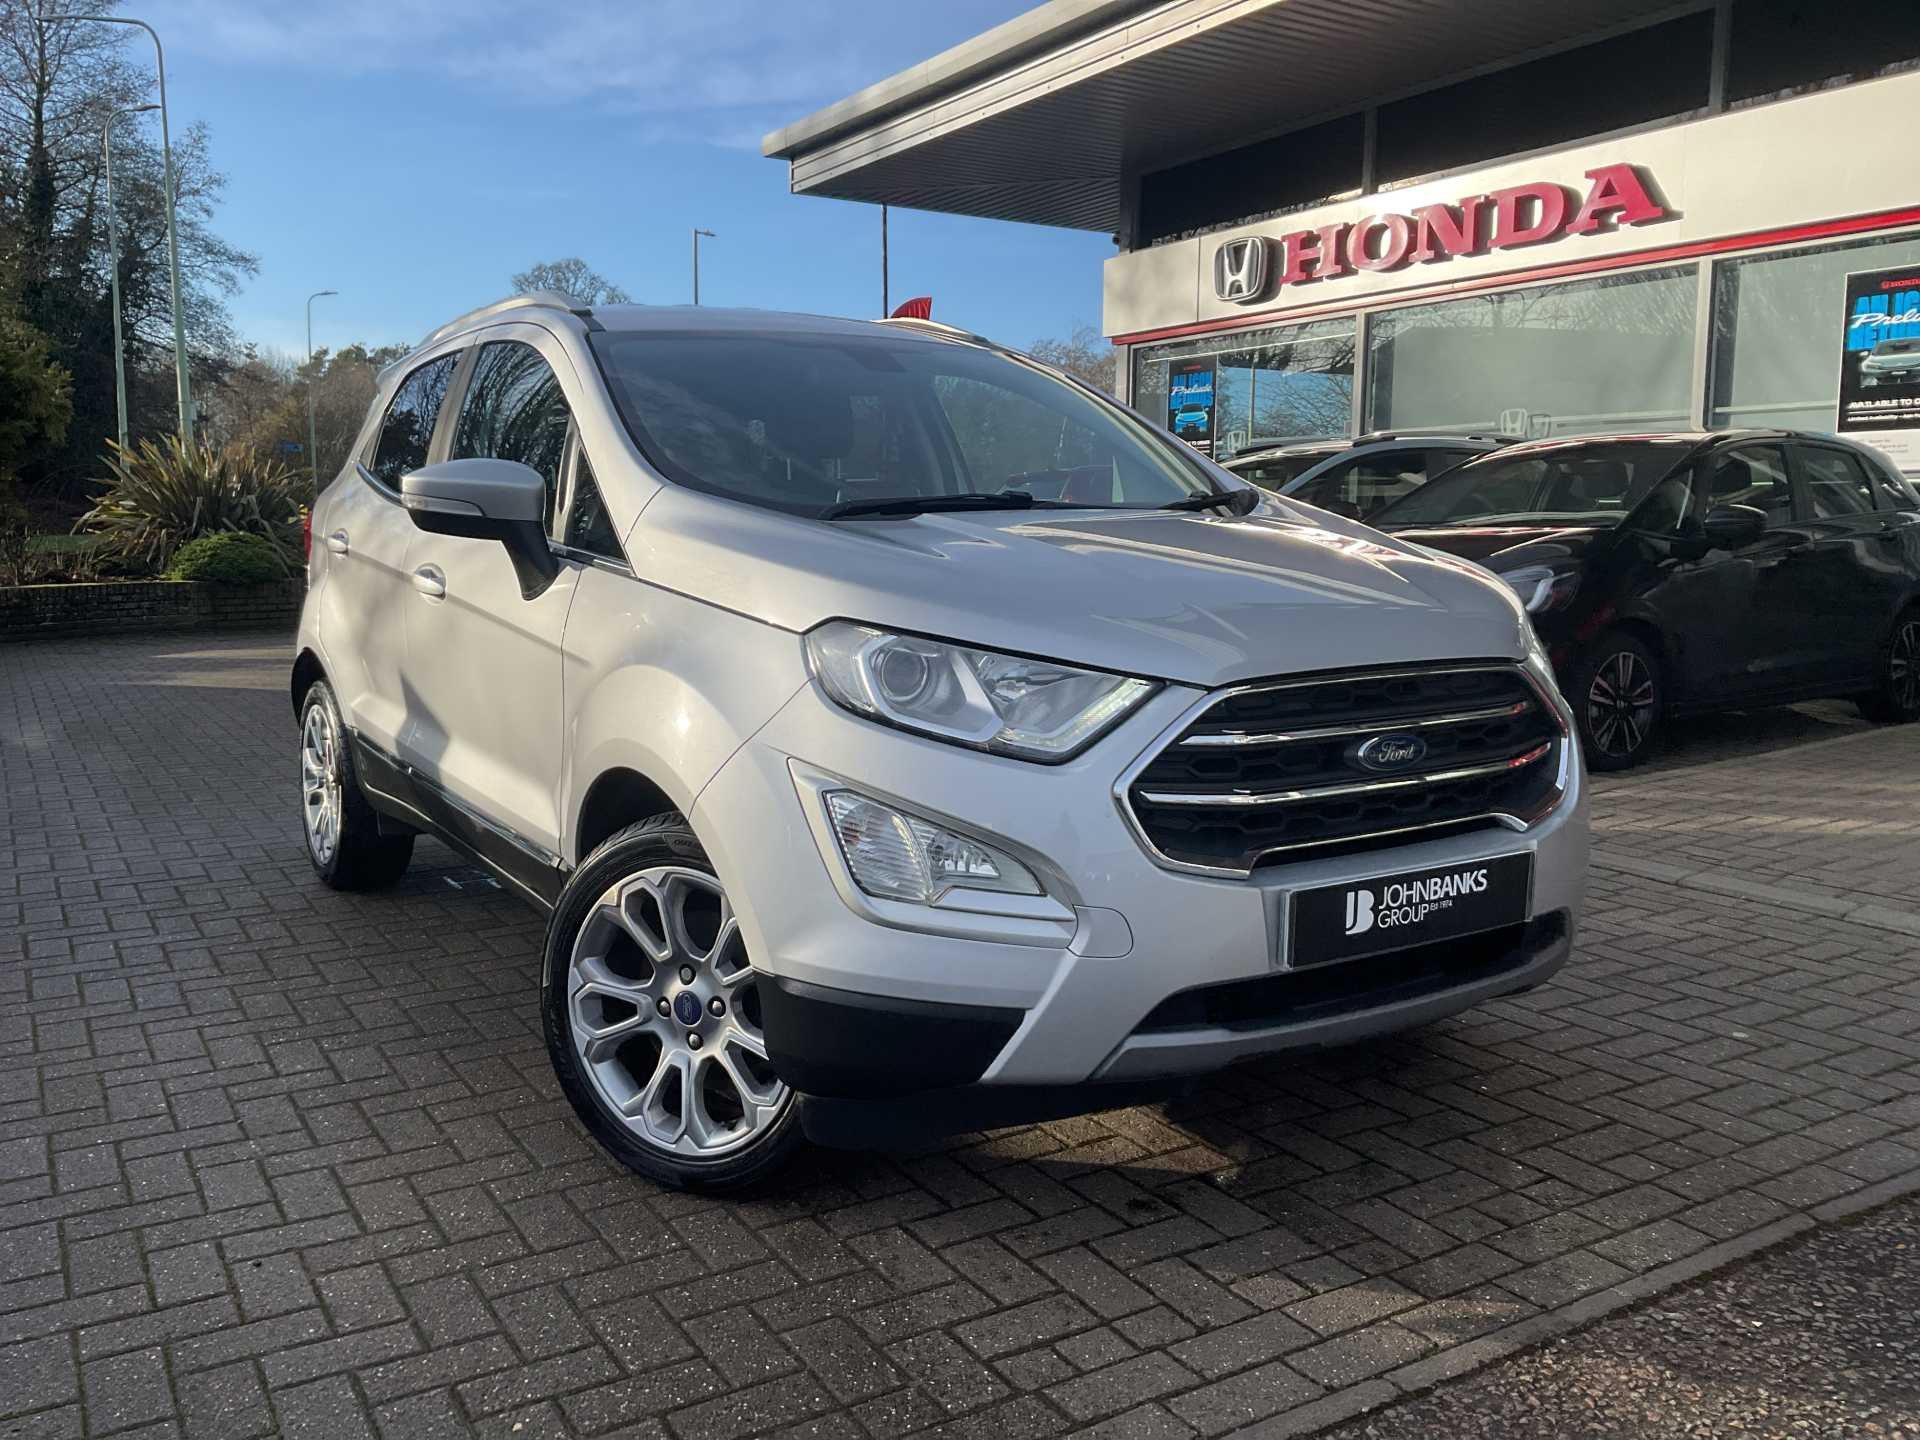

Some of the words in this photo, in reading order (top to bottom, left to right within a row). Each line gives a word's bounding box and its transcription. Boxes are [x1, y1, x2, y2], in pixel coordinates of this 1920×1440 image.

[1279, 162, 1664, 285] HONDA
[1848, 400, 1898, 409] AVAILABLE
[1900, 398, 1913, 406] TO
[1378, 741, 1416, 763] Ford
[1378, 869, 1488, 910] JOHNBANKS
[1378, 904, 1429, 928] GROUP
